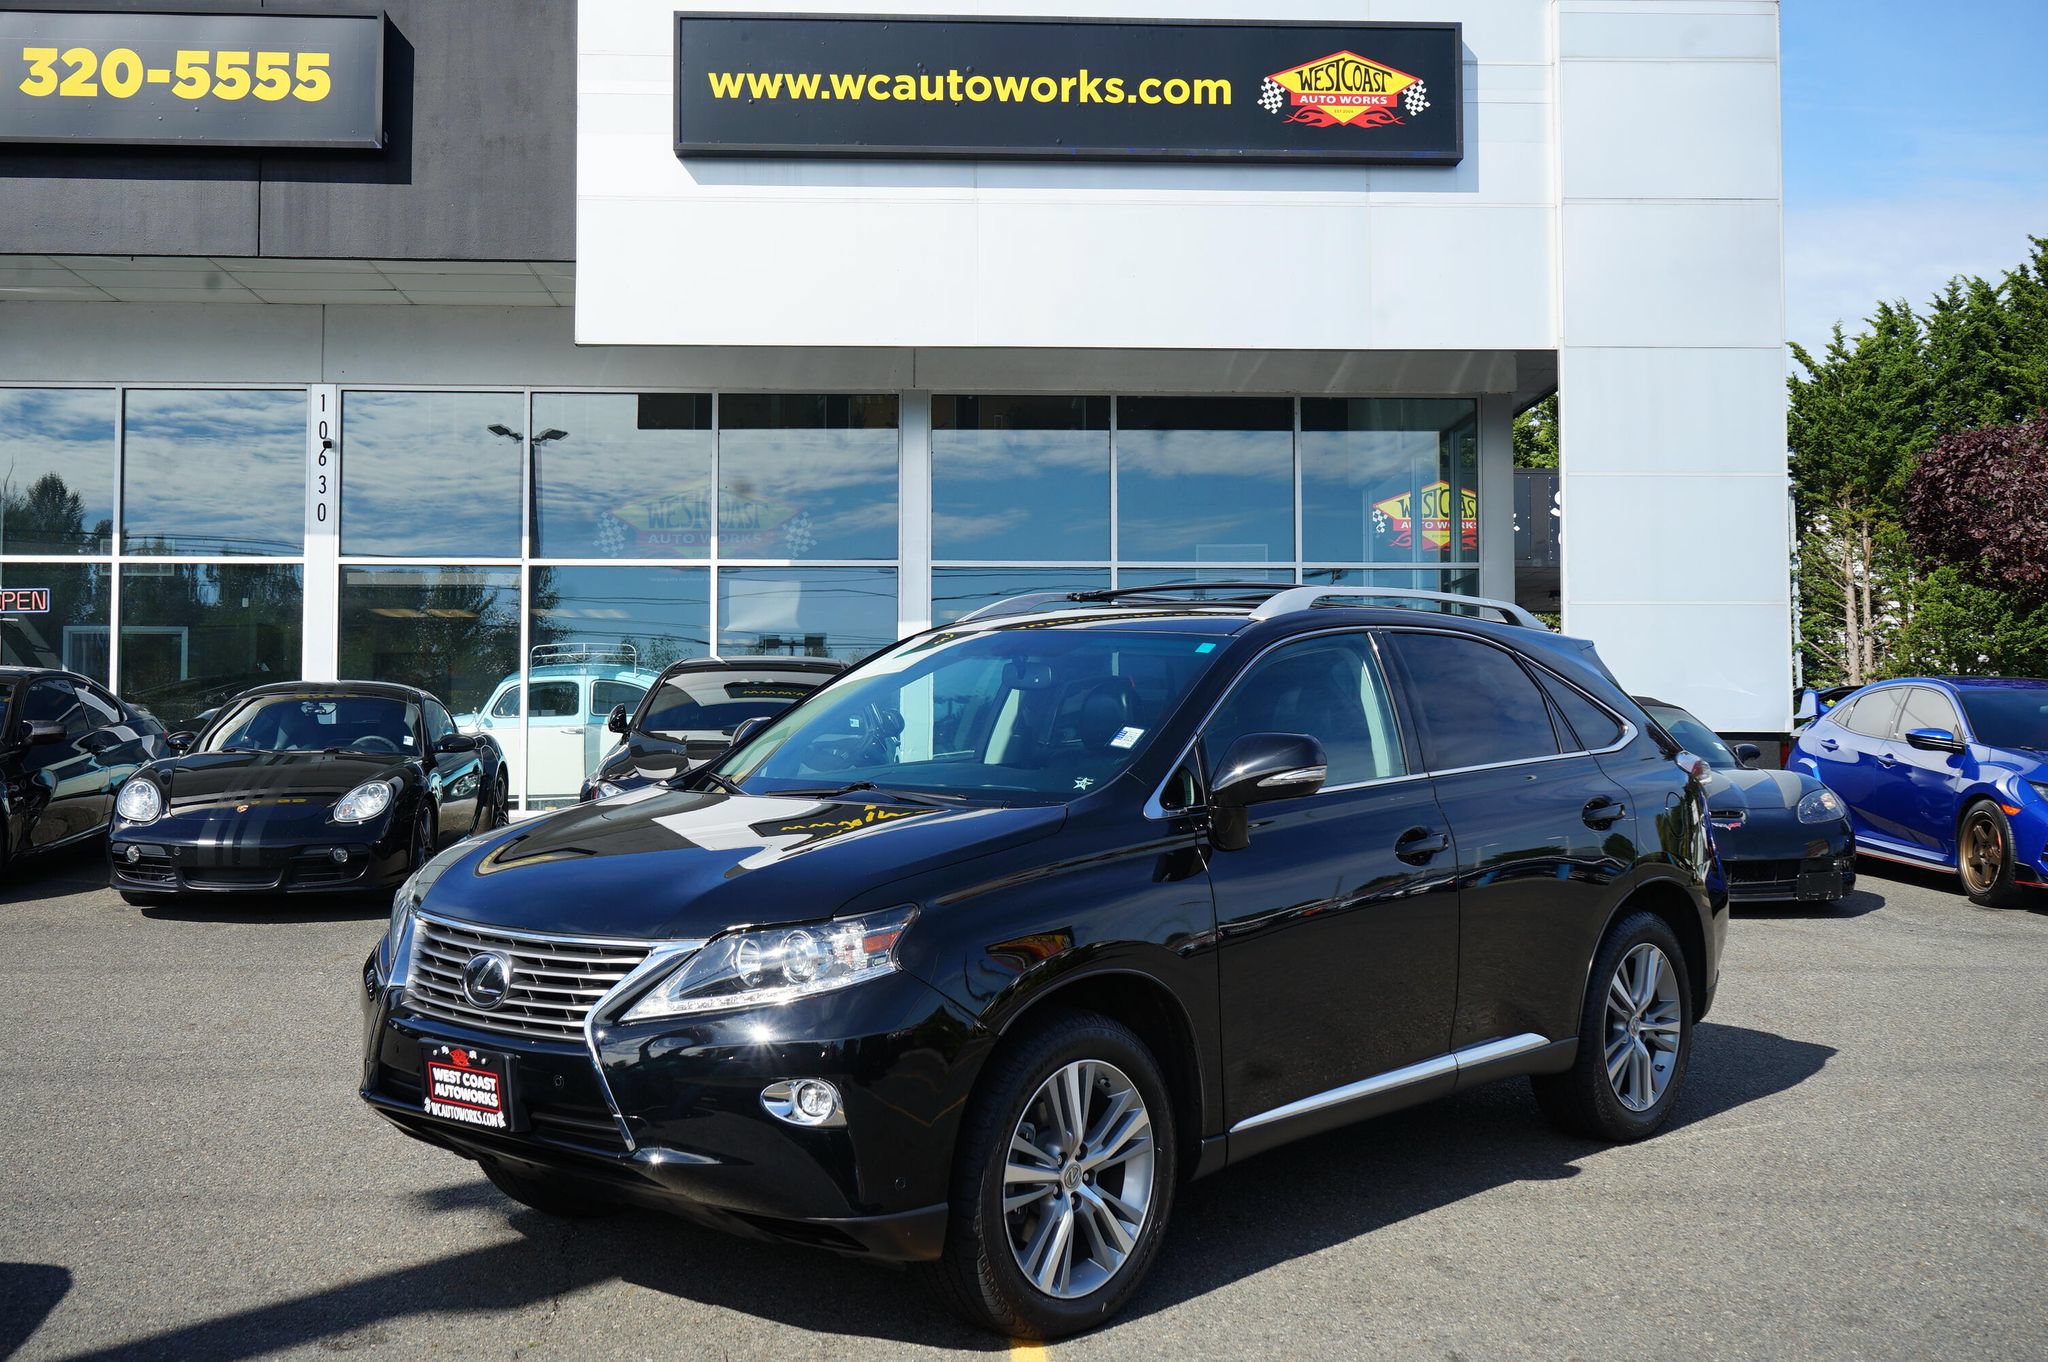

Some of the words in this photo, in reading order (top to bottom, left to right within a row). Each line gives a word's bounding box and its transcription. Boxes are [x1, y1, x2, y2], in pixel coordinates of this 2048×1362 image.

[19, 47, 331, 102] 320-5555
[708, 68, 1232, 105] www.wcautoworks.com
[1299, 95, 1337, 104] AUTO
[1339, 95, 1388, 105] WORKS
[648, 534, 695, 544] AUTO
[0, 591, 47, 611] PEN
[432, 1067, 462, 1083] WEST
[463, 1073, 497, 1091] COAST
[434, 1082, 498, 1107] AUTOWORKS
[431, 1102, 498, 1127] WCAUTOWORKS.COM
